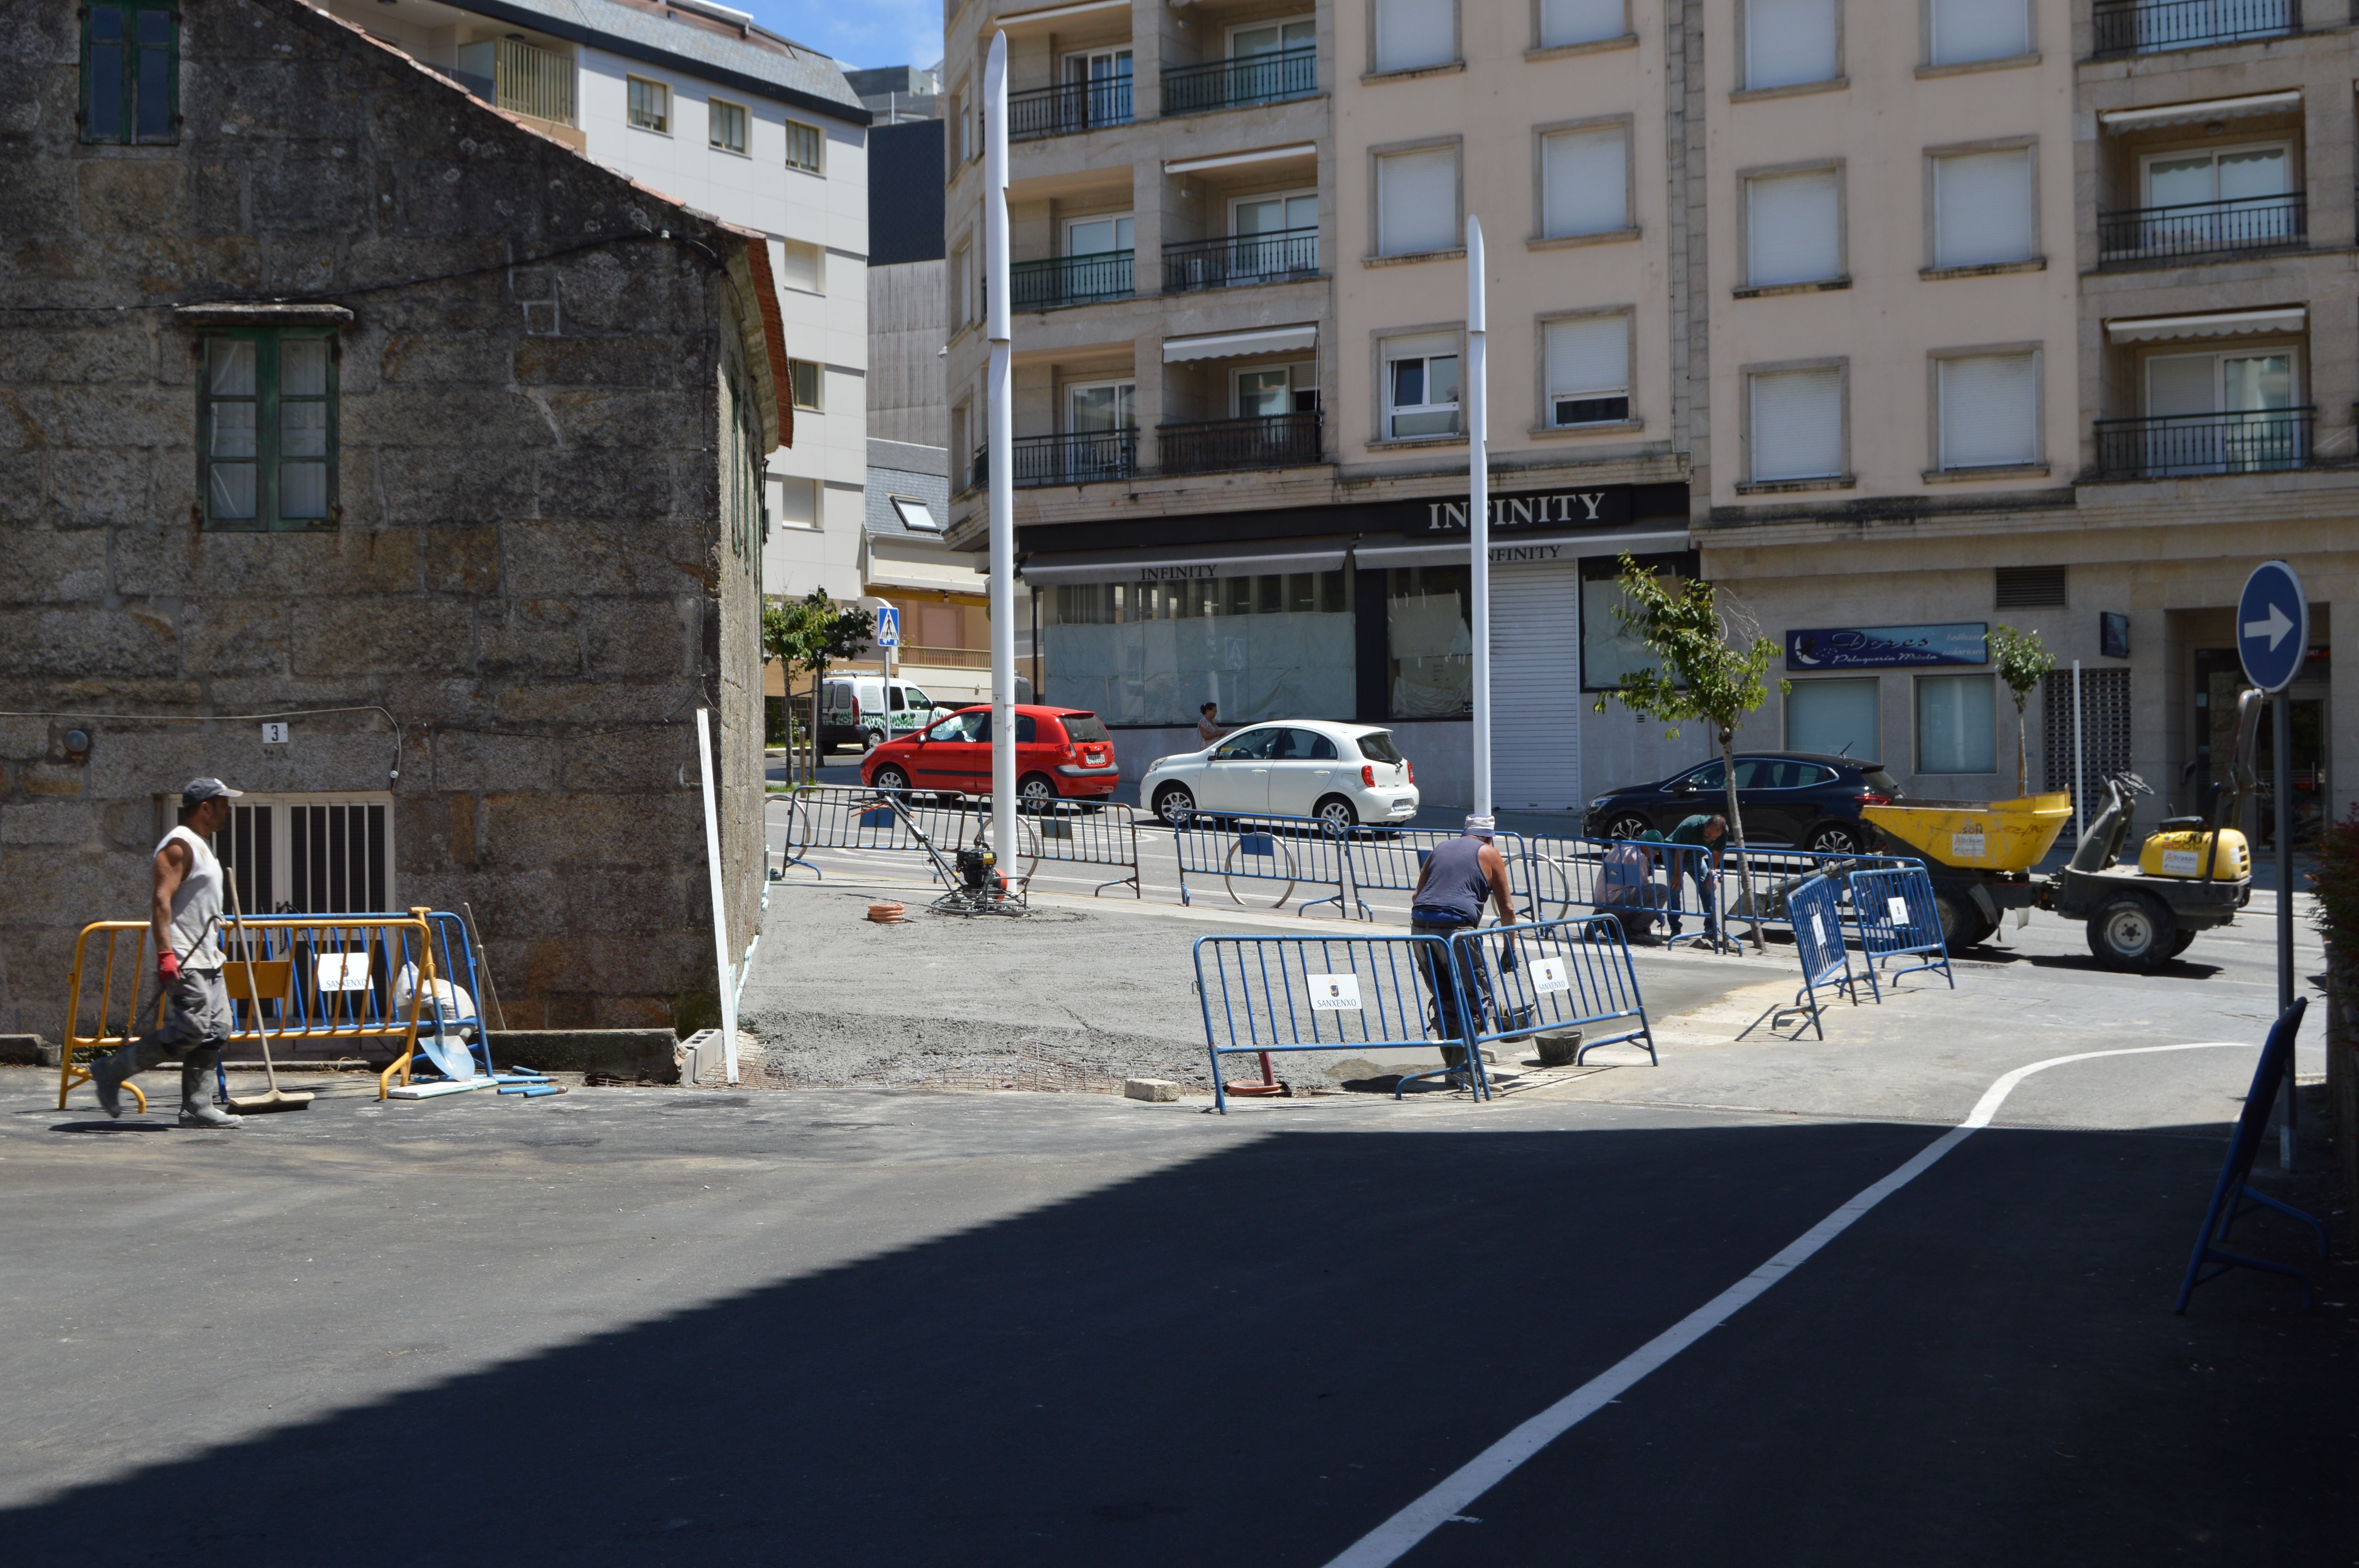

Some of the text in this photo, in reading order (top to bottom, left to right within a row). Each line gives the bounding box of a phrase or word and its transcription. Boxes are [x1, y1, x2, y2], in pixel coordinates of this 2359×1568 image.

[1428, 492, 1605, 530] ININITY
[1488, 545, 1561, 561] FINITY
[1140, 564, 1218, 580] INFINITY
[1830, 630, 1929, 649] Dores
[1941, 647, 1985, 656] solarium
[271, 725, 278, 741] 3
[1538, 980, 1565, 991] SANXENXO
[1317, 999, 1356, 1007] SANXENXO
